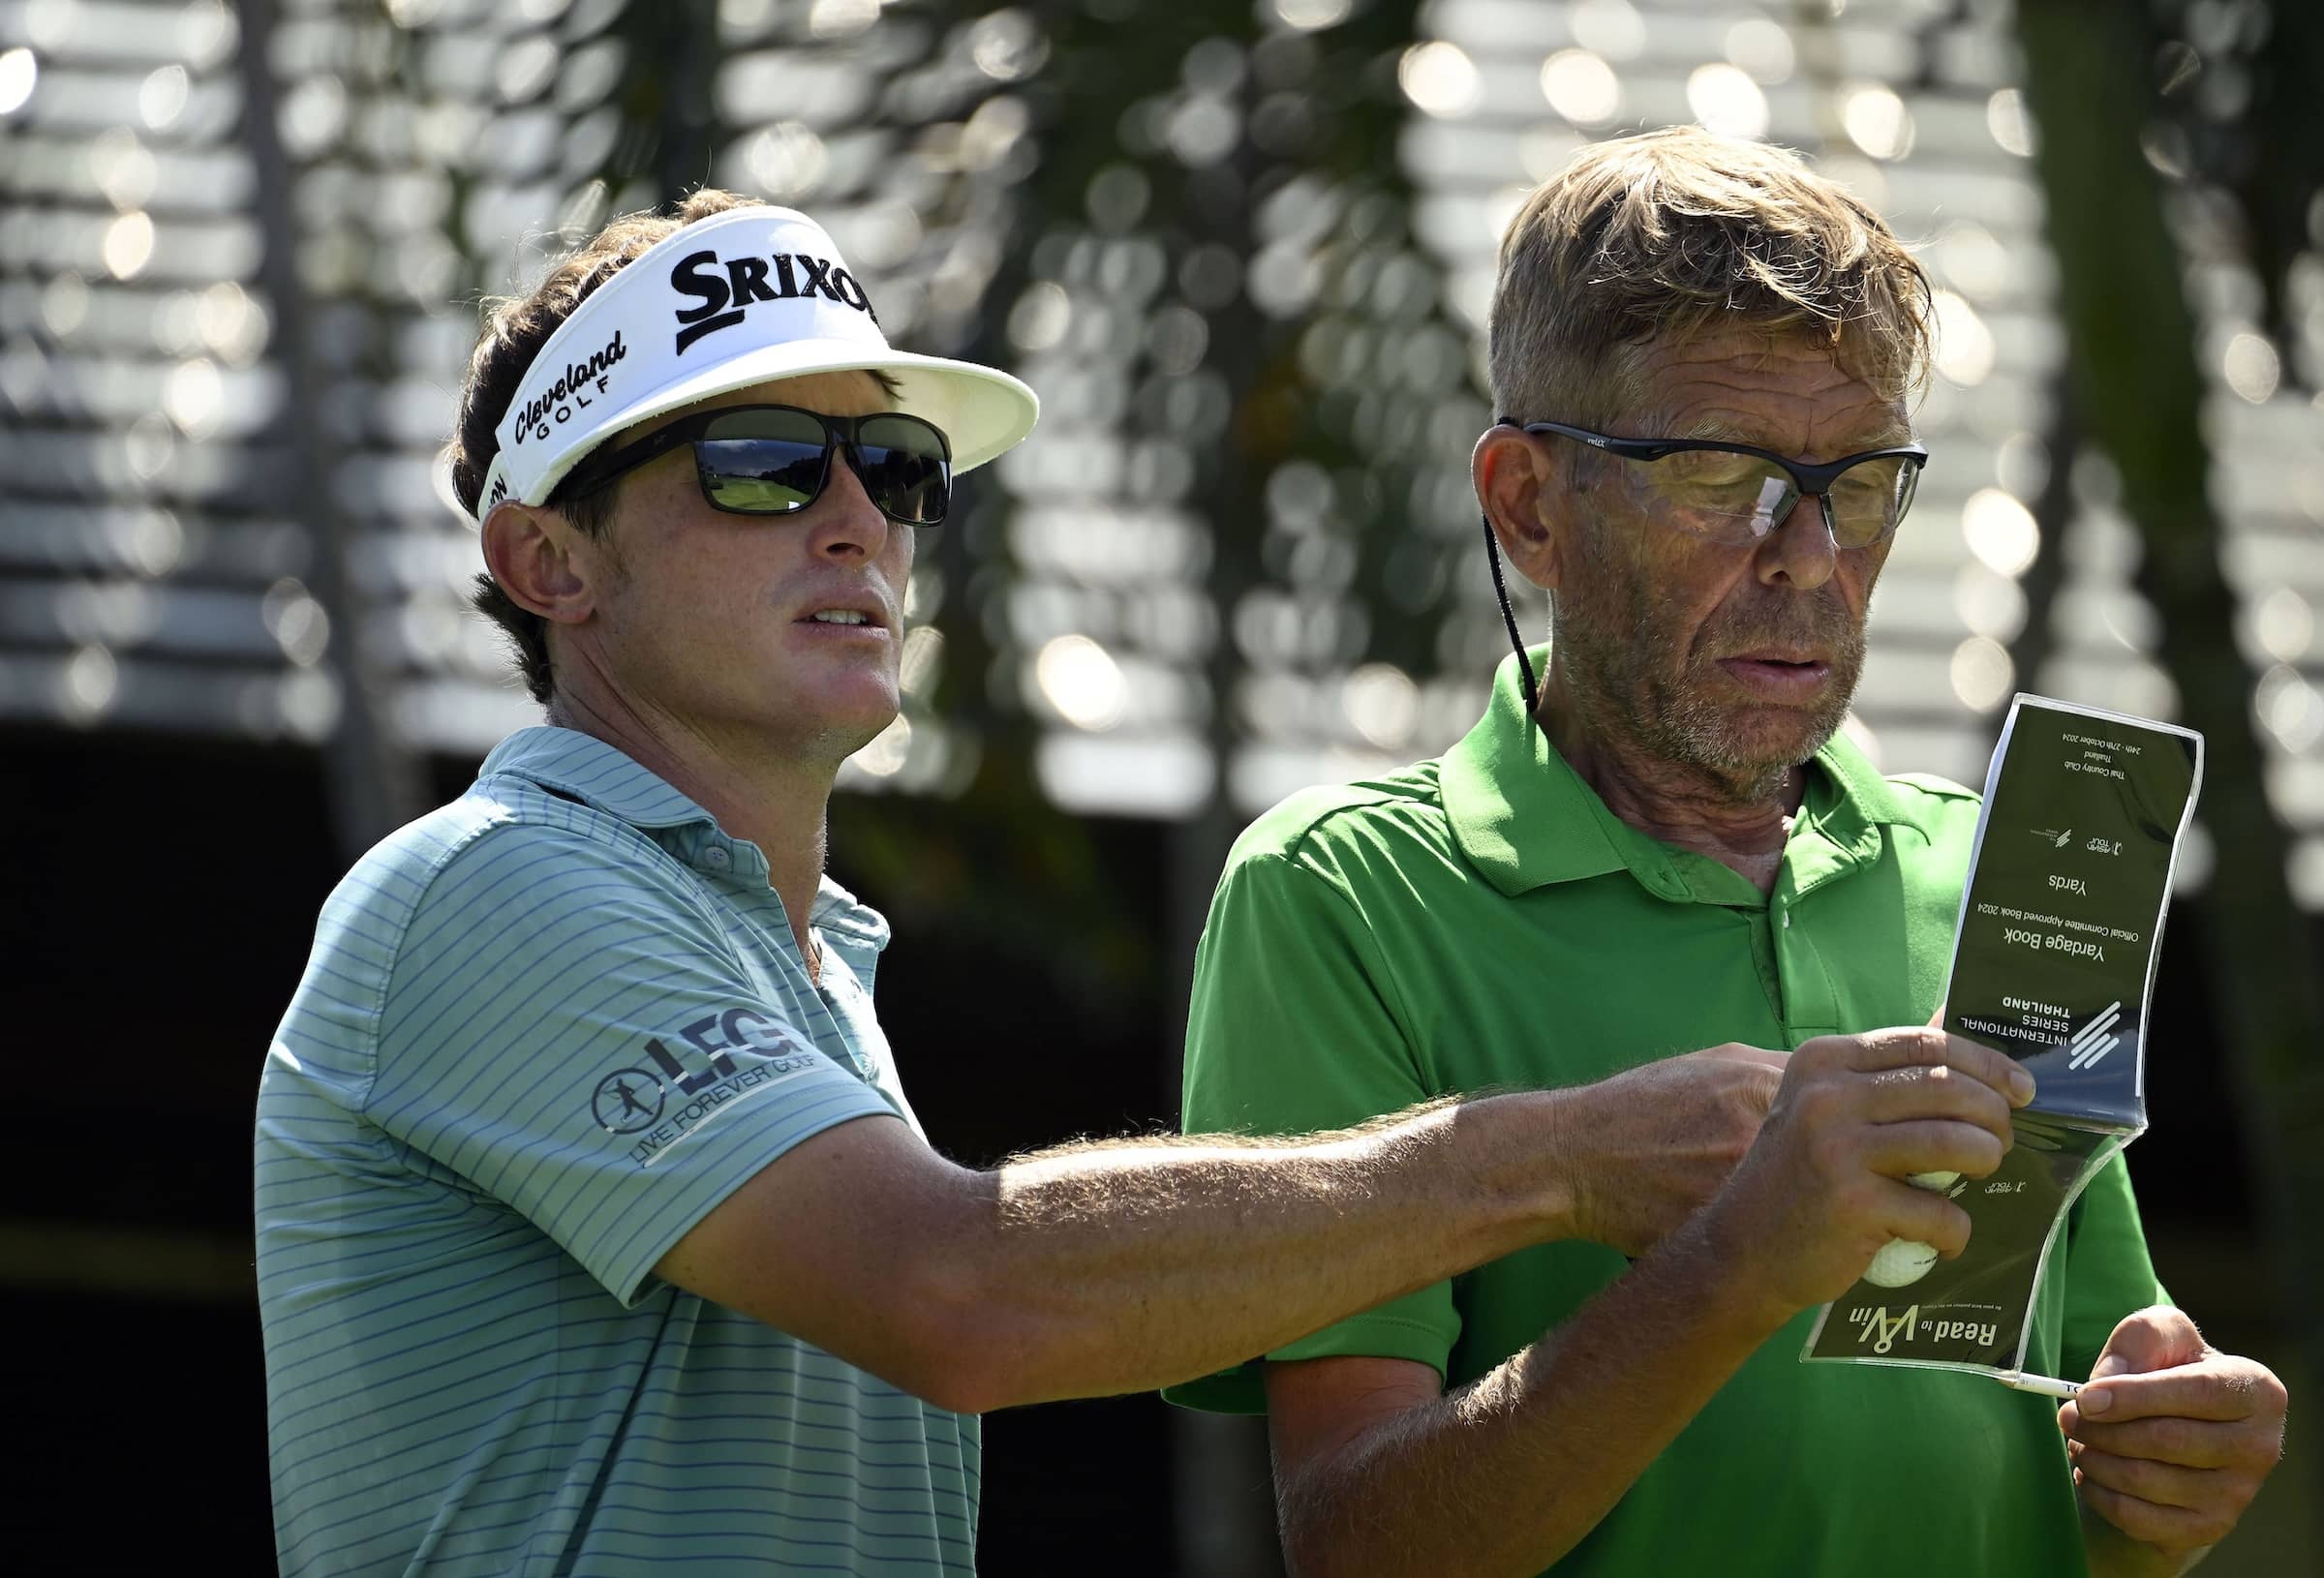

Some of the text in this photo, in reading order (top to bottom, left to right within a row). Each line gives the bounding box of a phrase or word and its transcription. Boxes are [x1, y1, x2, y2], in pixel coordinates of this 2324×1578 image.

[671, 250, 879, 324] SRIXO
[515, 330, 627, 444] Cleveland
[536, 375, 609, 440] GOLF
[2063, 733, 2080, 743] 2024
[2080, 737, 2106, 748] October
[2106, 742, 2121, 751] 27th
[2084, 750, 2111, 763] Thailand
[2125, 745, 2142, 755] 24th
[2064, 761, 2125, 780] Thai Country Club
[2048, 875, 2086, 895] Yards
[1977, 902, 2139, 943] Official Committee Approved Book 2024
[2003, 927, 2105, 962] Yardage Book
[2003, 996, 2070, 1018] THAILAND
[1960, 1017, 2067, 1047] INTERNATIONAL
[2022, 1015, 2069, 1033] SERIES
[644, 1008, 805, 1097] LFG
[629, 1054, 814, 1163] LIVE FOREVER GOLF
[1921, 1320, 1933, 1332] to
[1934, 1320, 1997, 1347] Read
